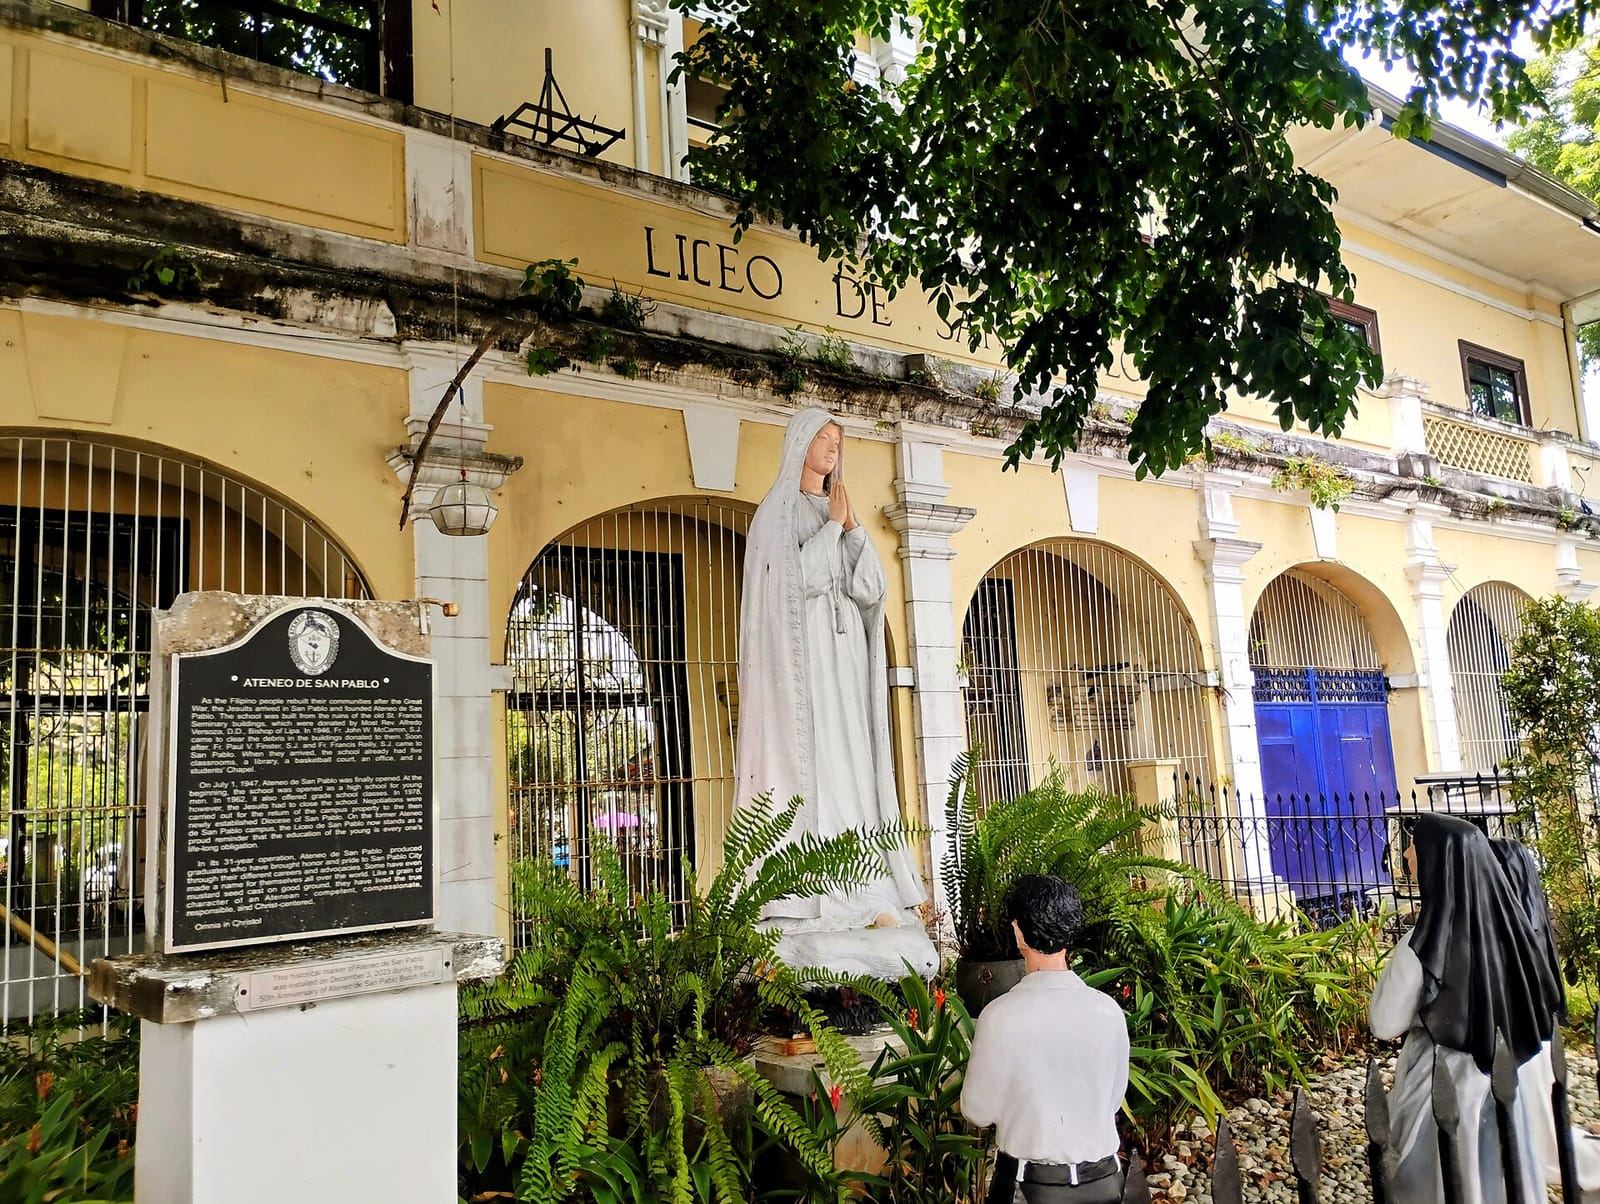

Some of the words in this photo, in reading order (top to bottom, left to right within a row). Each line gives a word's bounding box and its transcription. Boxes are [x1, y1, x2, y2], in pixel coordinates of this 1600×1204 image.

[644, 226, 783, 300] LICEO
[833, 269, 892, 327] DE
[243, 678, 294, 688] ATENEO
[296, 678, 312, 688] DE
[315, 679, 339, 688] SAN
[342, 680, 380, 688] PABLO
[296, 786, 323, 794] opened
[347, 784, 361, 792] high
[389, 846, 422, 855] produced
[270, 861, 300, 870] brought
[341, 858, 359, 866] pride
[396, 868, 413, 877] grain
[187, 875, 218, 883] through
